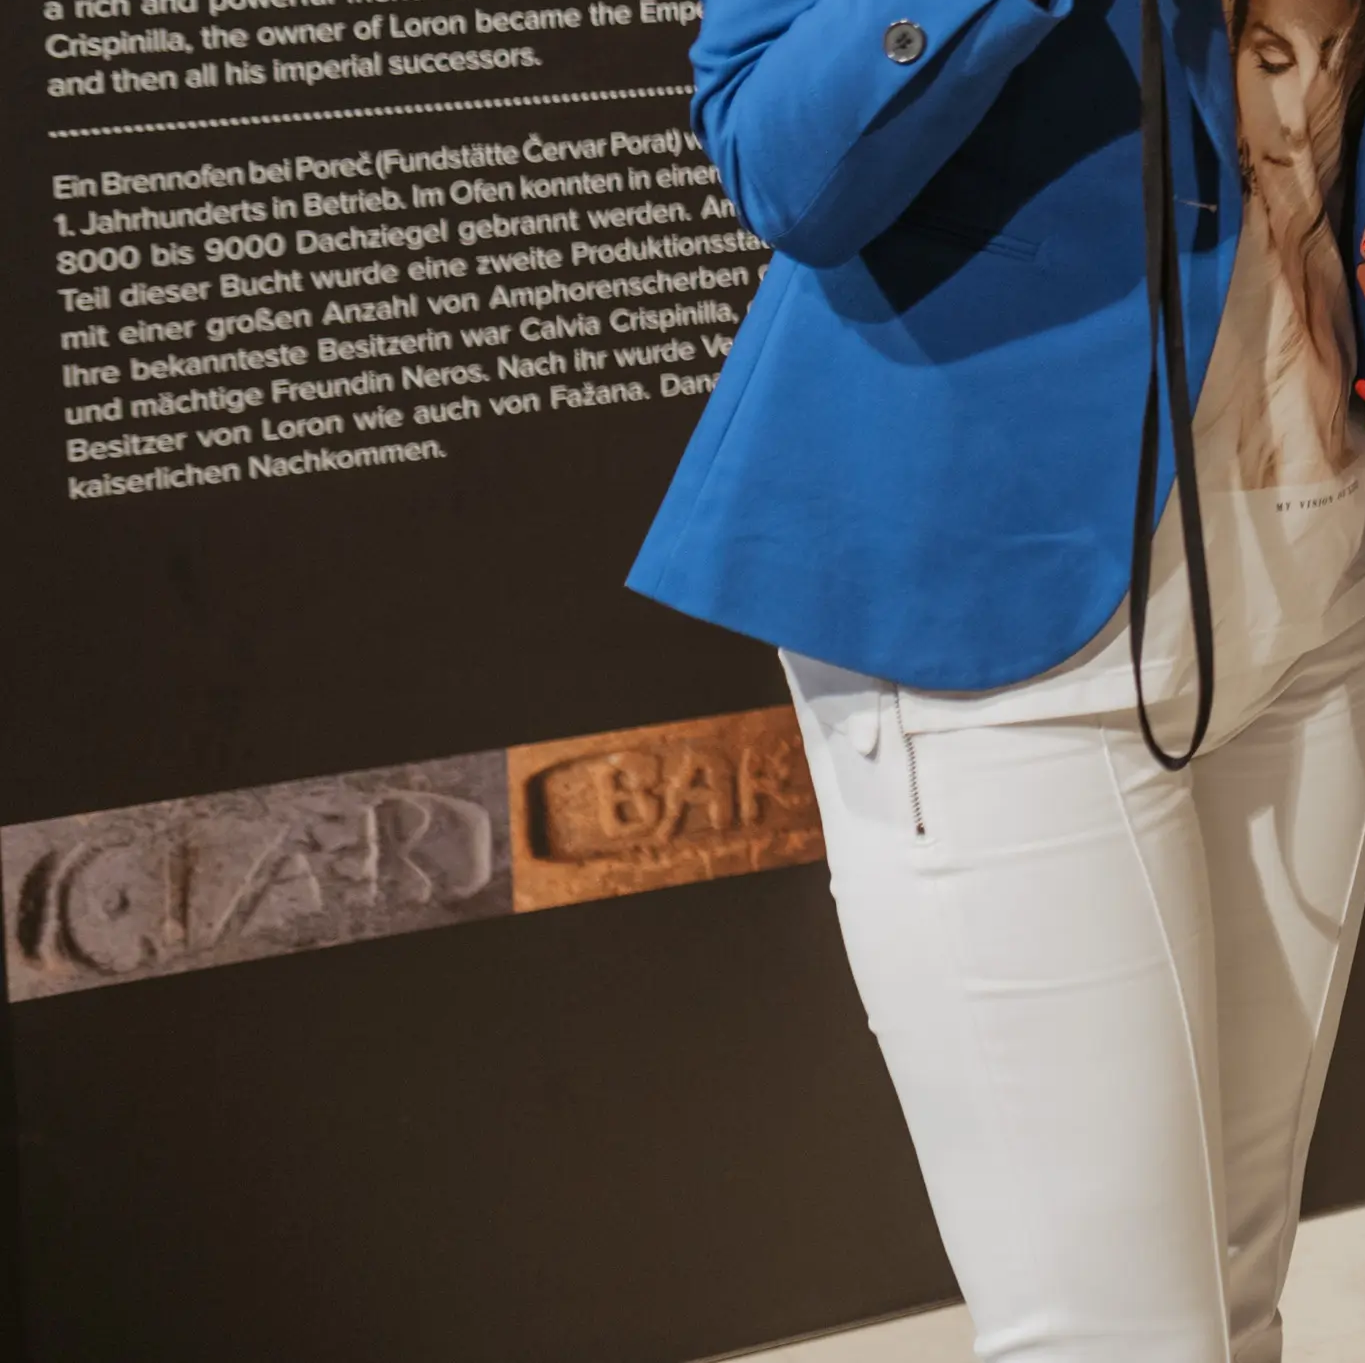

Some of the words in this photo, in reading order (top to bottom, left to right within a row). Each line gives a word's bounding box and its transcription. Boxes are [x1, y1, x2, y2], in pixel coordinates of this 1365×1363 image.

[45, 28, 194, 61] Crispinilla,
[256, 22, 346, 47] owner
[389, 13, 467, 39] Loron
[475, 7, 582, 33] became
[273, 51, 382, 86] imperial
[388, 46, 542, 75] successors.
[101, 163, 245, 196] Brennofen
[610, 128, 682, 157] Porat)
[80, 200, 268, 236] Jahrhunderts
[302, 187, 407, 217] Betrieb.
[519, 172, 623, 200] konnten
[56, 245, 141, 275] 8000
[204, 232, 286, 263] 9000
[295, 218, 448, 255] Dachziegel
[457, 208, 580, 246] gebrannt
[586, 200, 692, 229] werden.
[118, 320, 196, 345] einer
[322, 293, 418, 326] Anzahl
[488, 266, 749, 311] Amphorenscherben
[119, 281, 212, 307] dieser
[219, 269, 304, 298] Bucht
[310, 260, 399, 290] wurde
[476, 246, 563, 275] zweite
[130, 344, 308, 381] bekannteste
[317, 328, 452, 363] Besitzerin
[519, 313, 601, 342] Calvia
[609, 300, 739, 334] Crispinilla,
[271, 370, 395, 404] Freundin
[401, 363, 490, 390] Neros.
[613, 338, 696, 368] wurde
[66, 432, 188, 463] Besitzer
[261, 414, 344, 441] Loron
[68, 463, 241, 500] kaiserlichen
[248, 439, 447, 479] Nachkommen.
